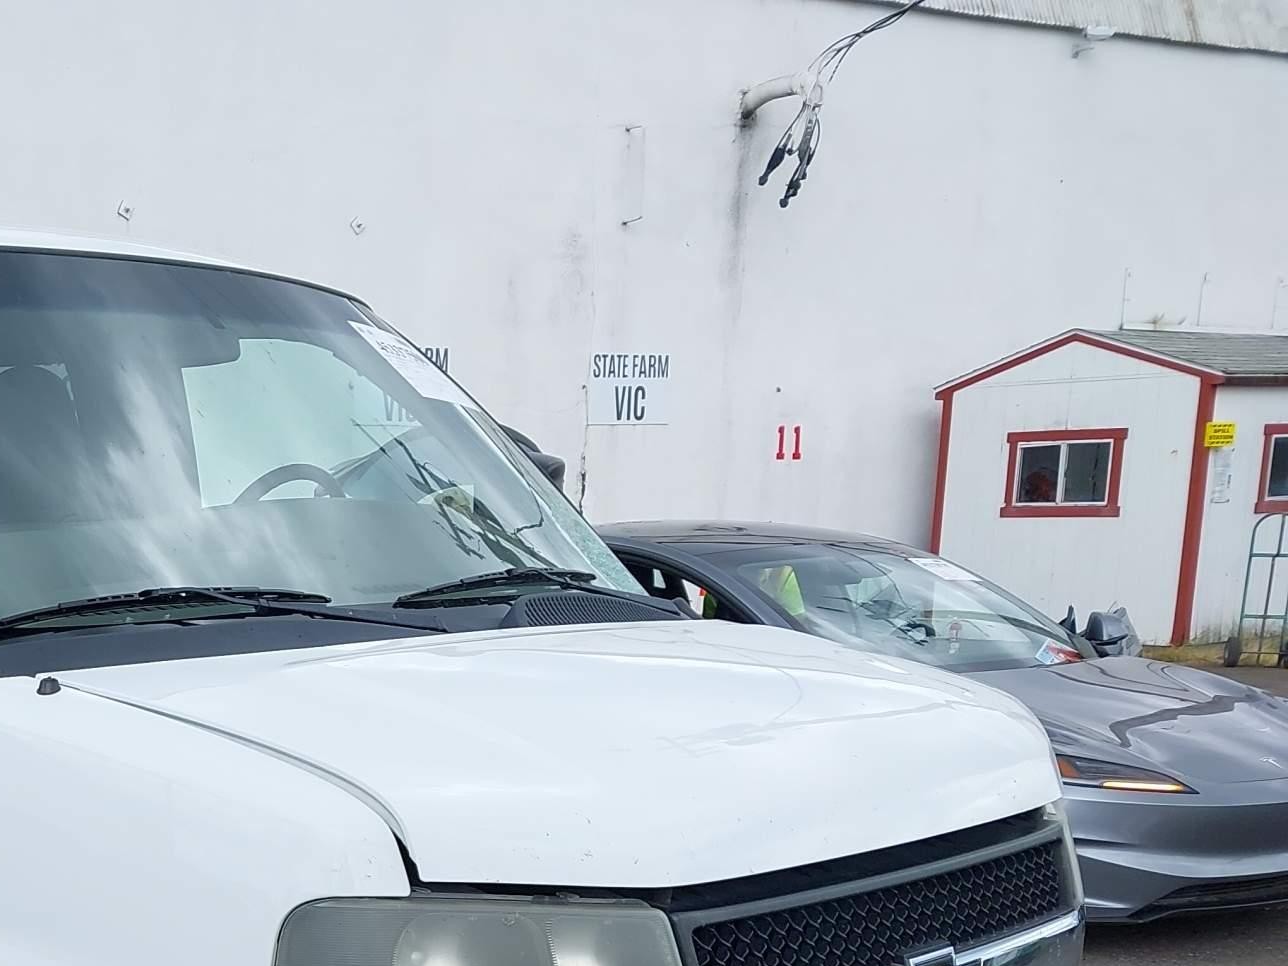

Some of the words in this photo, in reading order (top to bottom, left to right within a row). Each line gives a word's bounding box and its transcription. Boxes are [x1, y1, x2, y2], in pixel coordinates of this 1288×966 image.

[592, 353, 629, 379] STATE
[632, 353, 670, 379] FARM
[614, 385, 646, 421] VIC
[776, 424, 802, 460] 11
